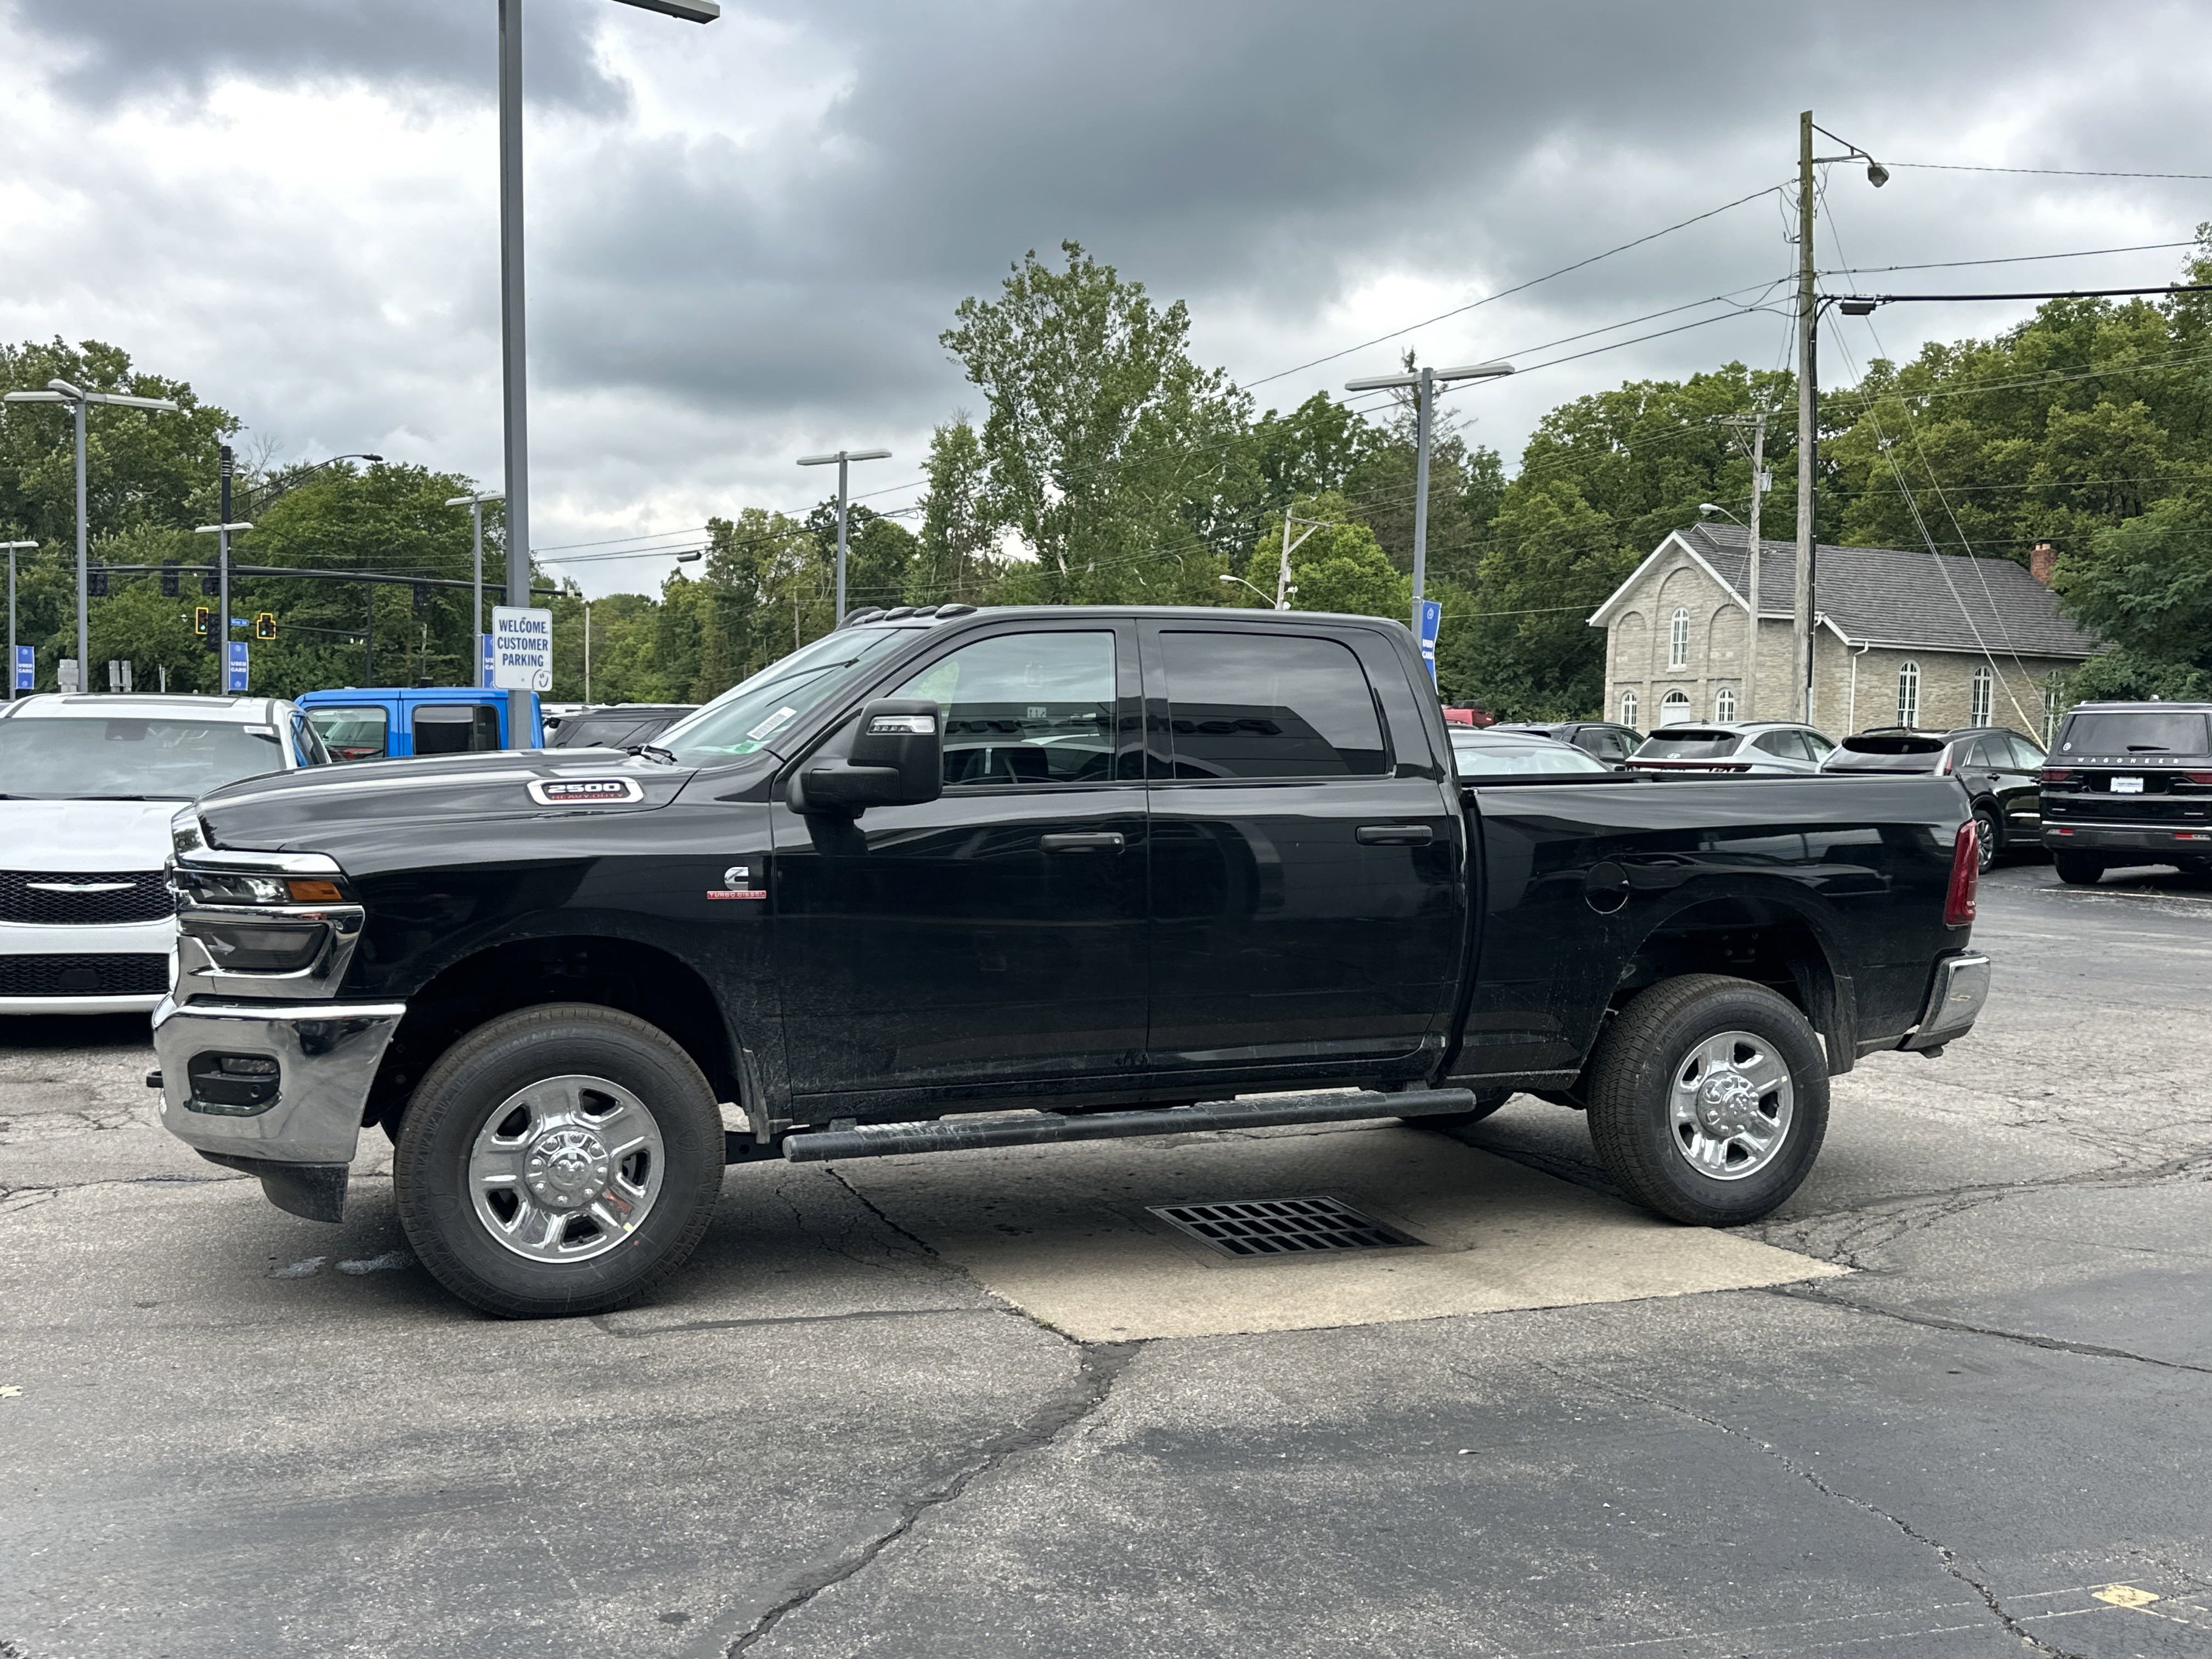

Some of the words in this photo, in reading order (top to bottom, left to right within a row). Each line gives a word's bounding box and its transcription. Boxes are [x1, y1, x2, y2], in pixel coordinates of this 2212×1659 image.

[499, 619, 546, 634] WELCOME
[497, 636, 548, 651] CUSTOMER
[503, 653, 544, 667] PARKING
[548, 783, 620, 794] 2500
